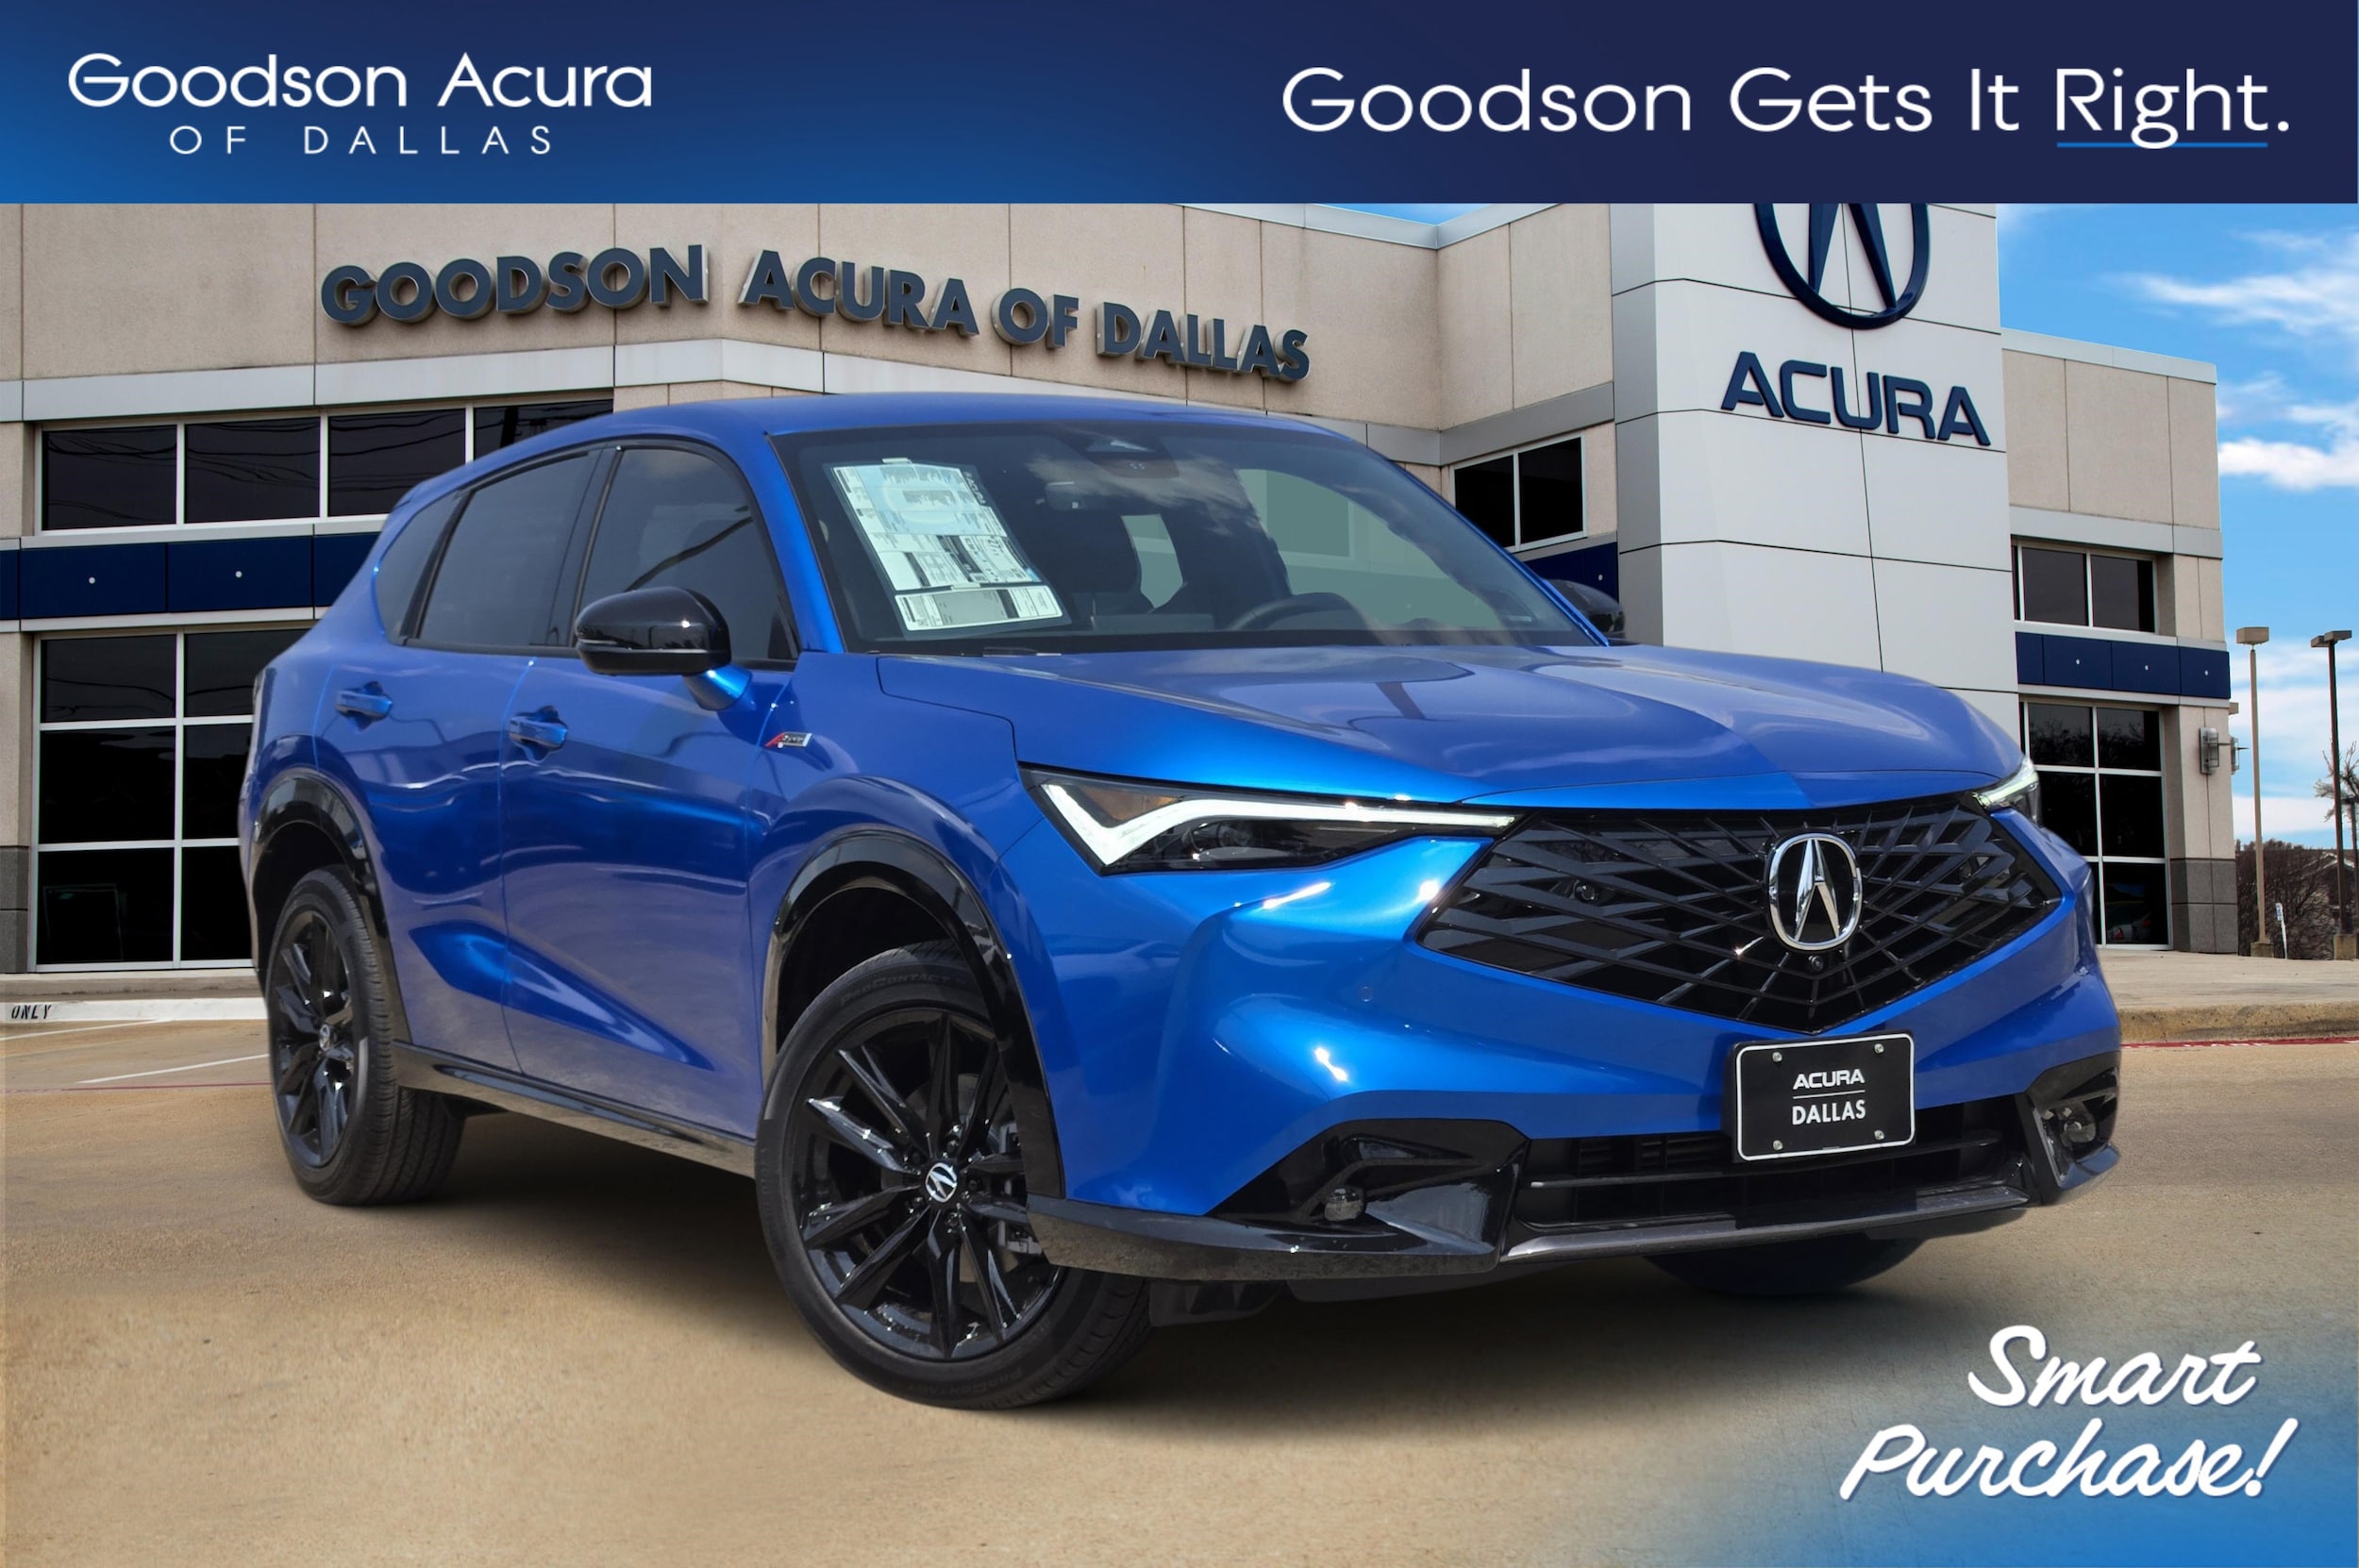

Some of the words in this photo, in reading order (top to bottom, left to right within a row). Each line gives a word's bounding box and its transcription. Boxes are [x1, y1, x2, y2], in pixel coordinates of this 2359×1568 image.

[321, 244, 710, 326] GOODSON
[738, 249, 980, 337] ACURA
[992, 287, 1079, 350] OF
[1096, 300, 1311, 383] DALLAS
[1720, 350, 1992, 447] ACURA
[11, 1004, 53, 1020] ONLY
[1792, 1067, 1865, 1091] ACURA
[1791, 1099, 1866, 1126] DALLAS
